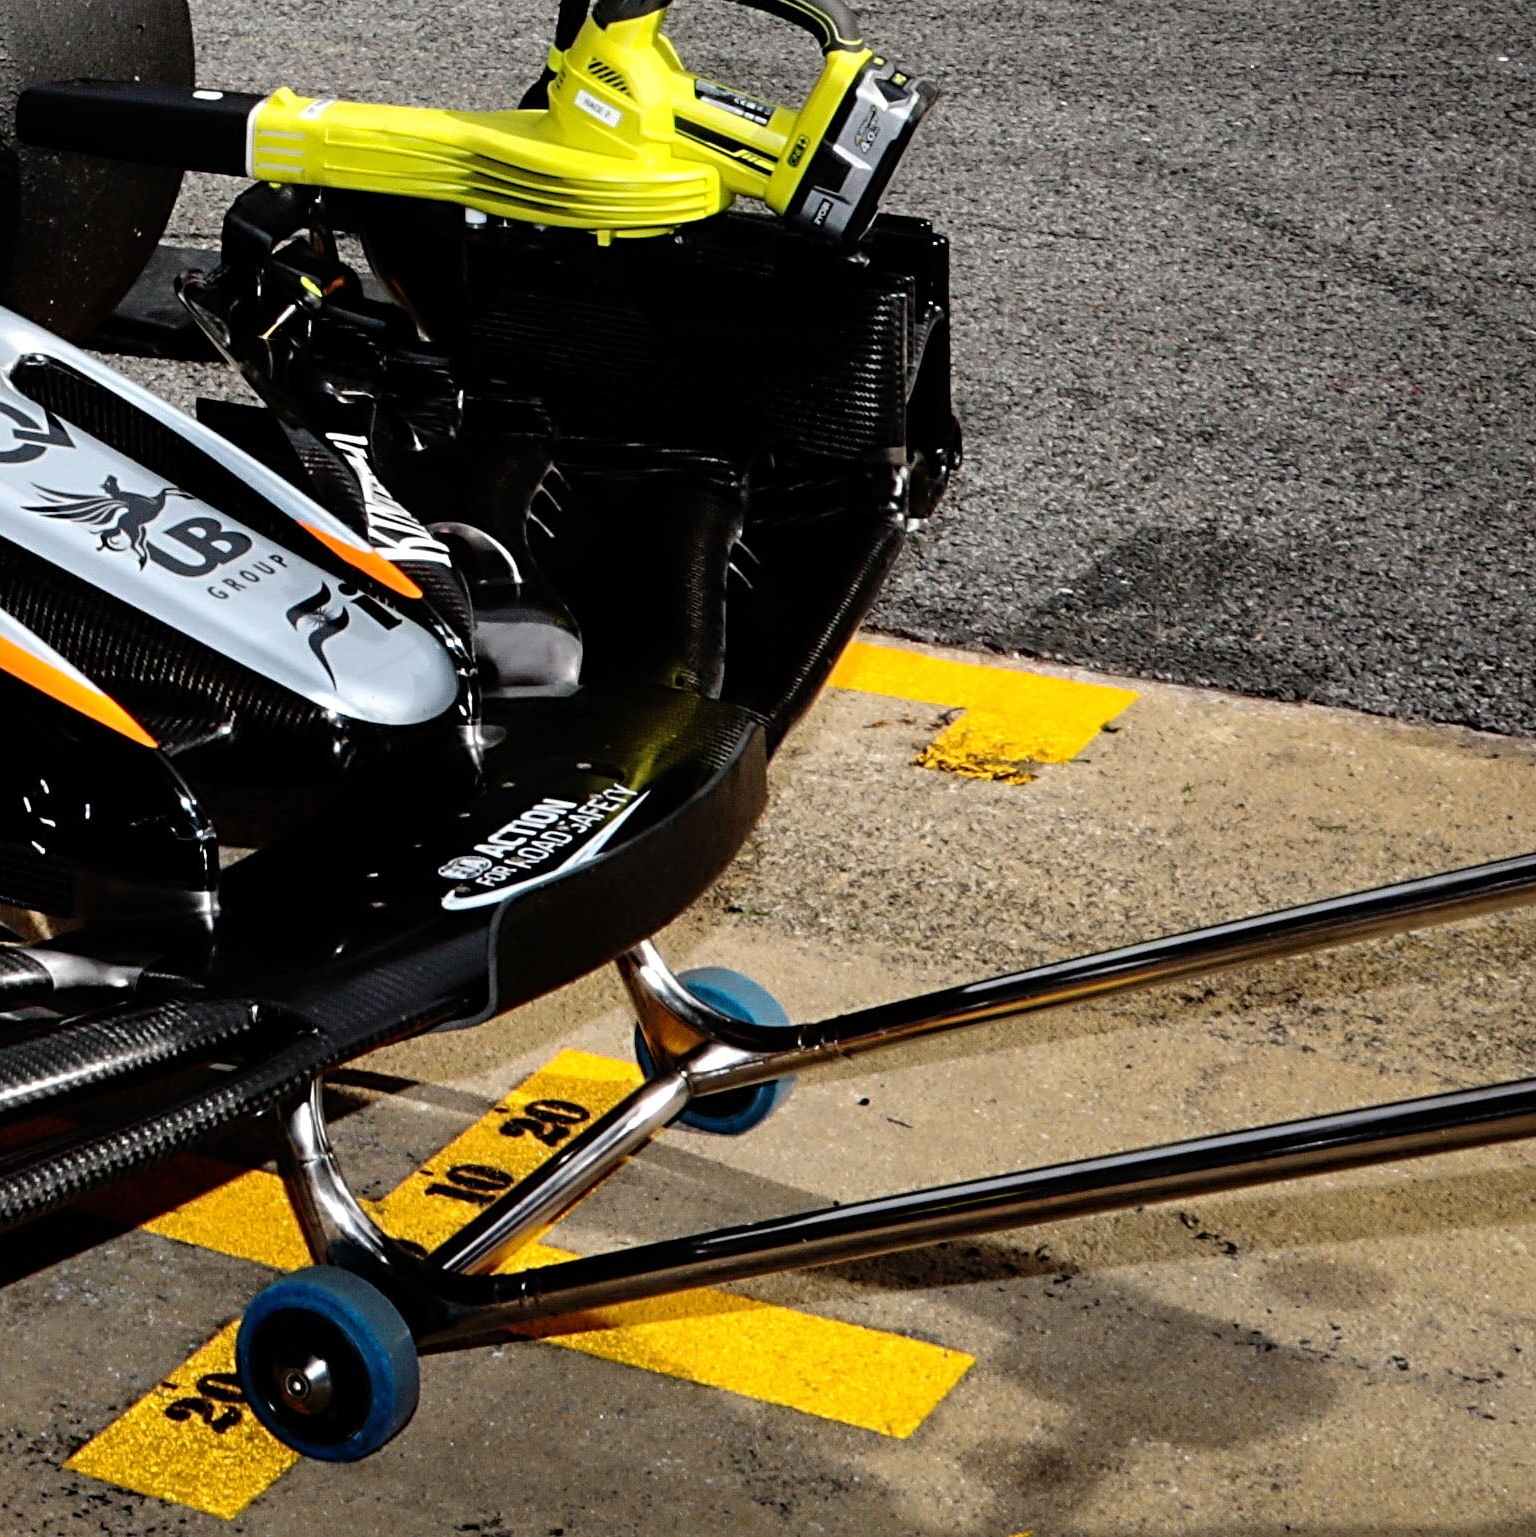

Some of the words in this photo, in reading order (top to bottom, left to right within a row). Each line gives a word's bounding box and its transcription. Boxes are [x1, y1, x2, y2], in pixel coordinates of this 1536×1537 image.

[144, 513, 253, 580] UB
[207, 552, 291, 602] GROUP
[473, 797, 578, 859] ACTION
[475, 864, 518, 888] FOR
[499, 1099, 591, 1147] 20
[424, 1162, 515, 1206] 10
